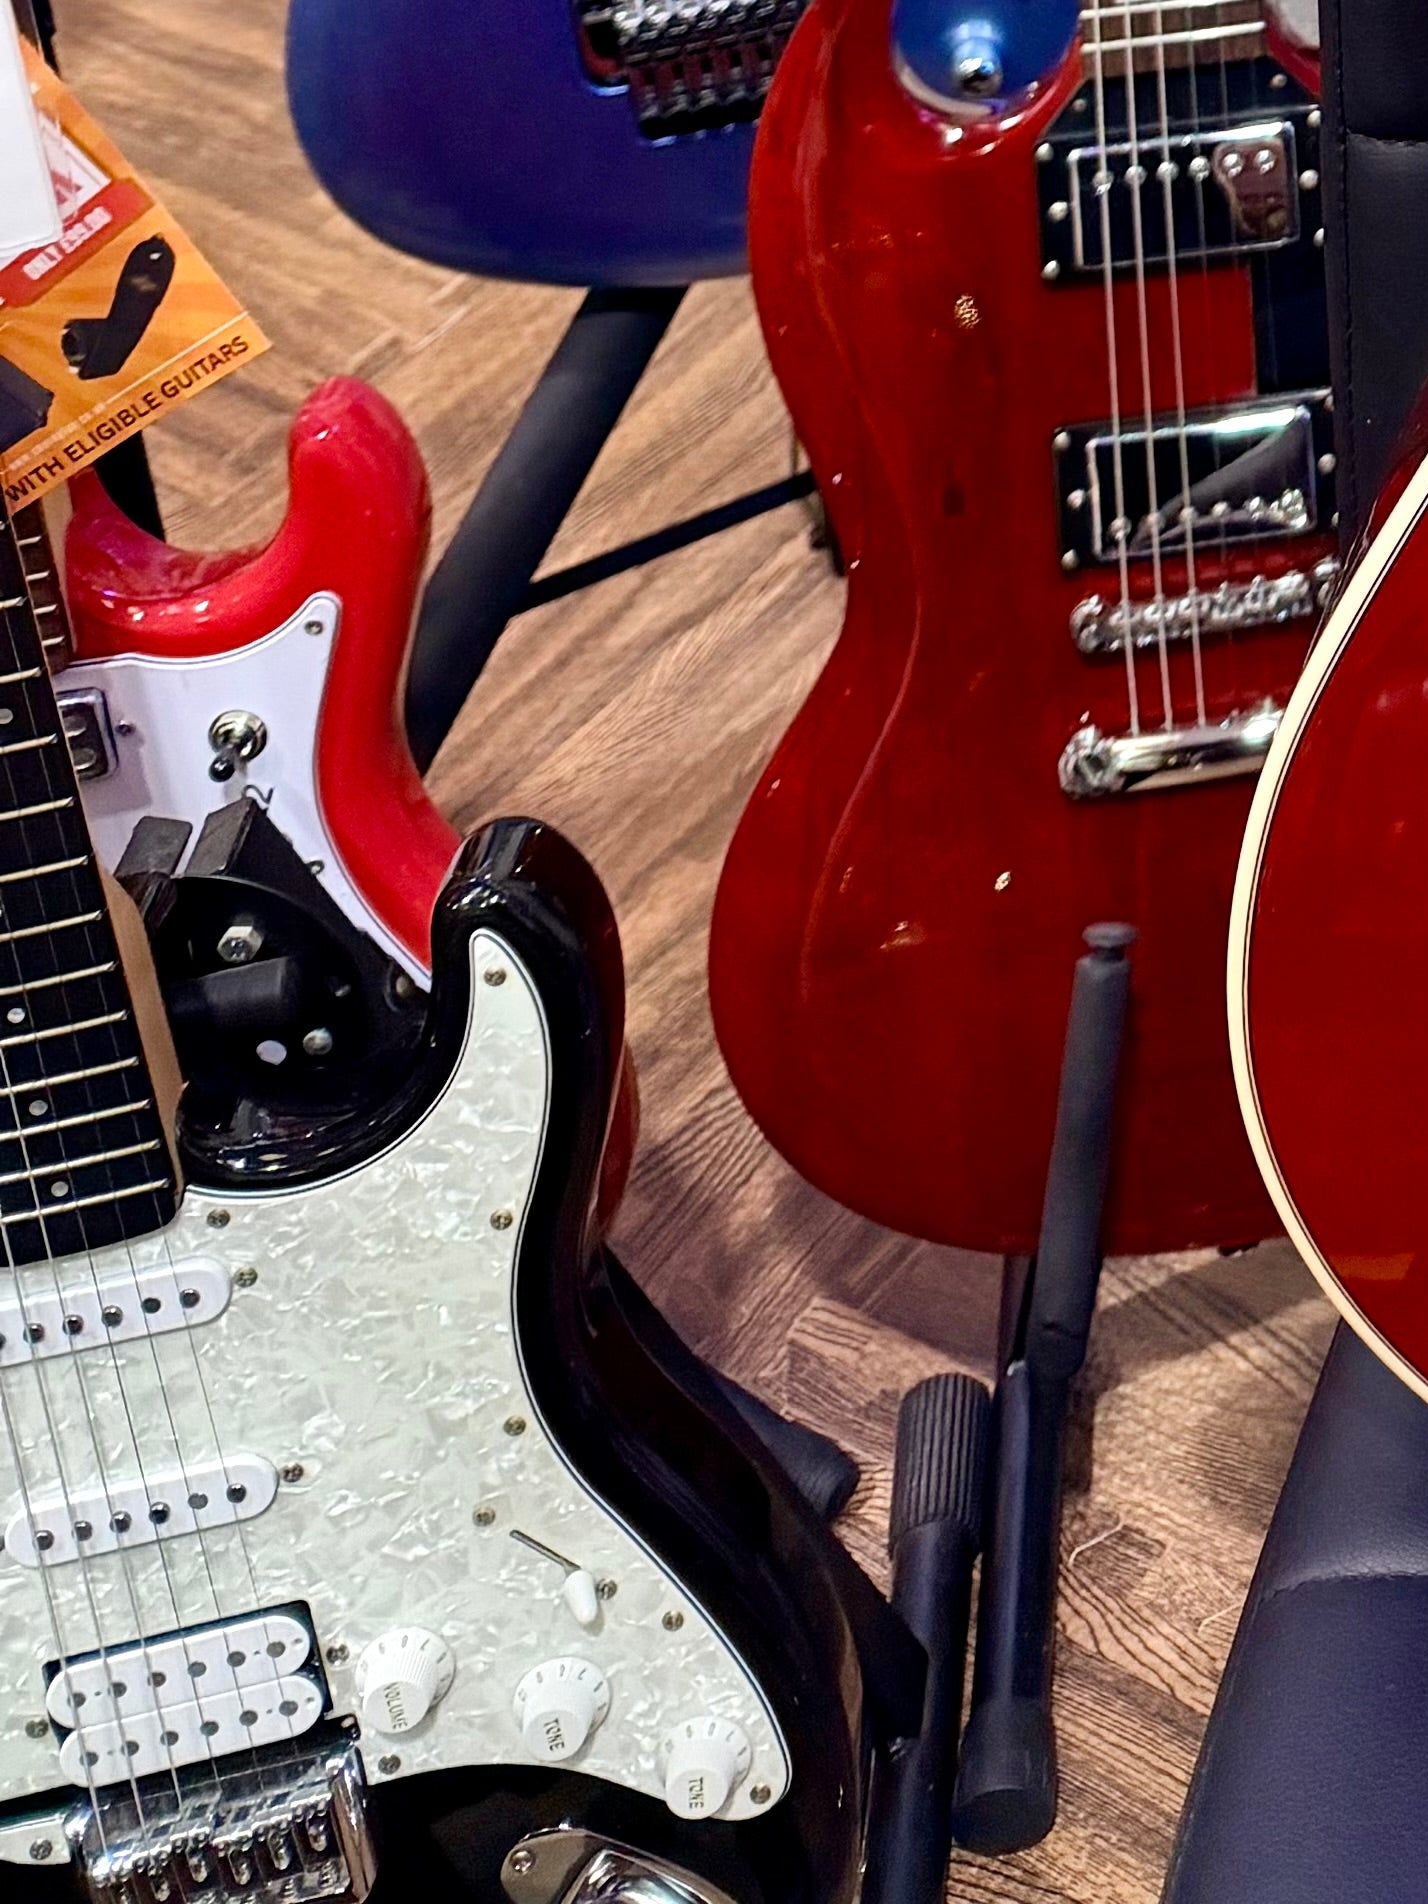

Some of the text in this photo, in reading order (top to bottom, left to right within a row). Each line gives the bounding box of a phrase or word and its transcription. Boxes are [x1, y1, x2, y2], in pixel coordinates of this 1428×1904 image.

[5, 455, 66, 502] WITH
[63, 390, 163, 464] ELIGIBLE
[160, 334, 250, 399] GUITARS
[543, 1717, 566, 1752] TONE
[688, 1776, 705, 1809] TONE
